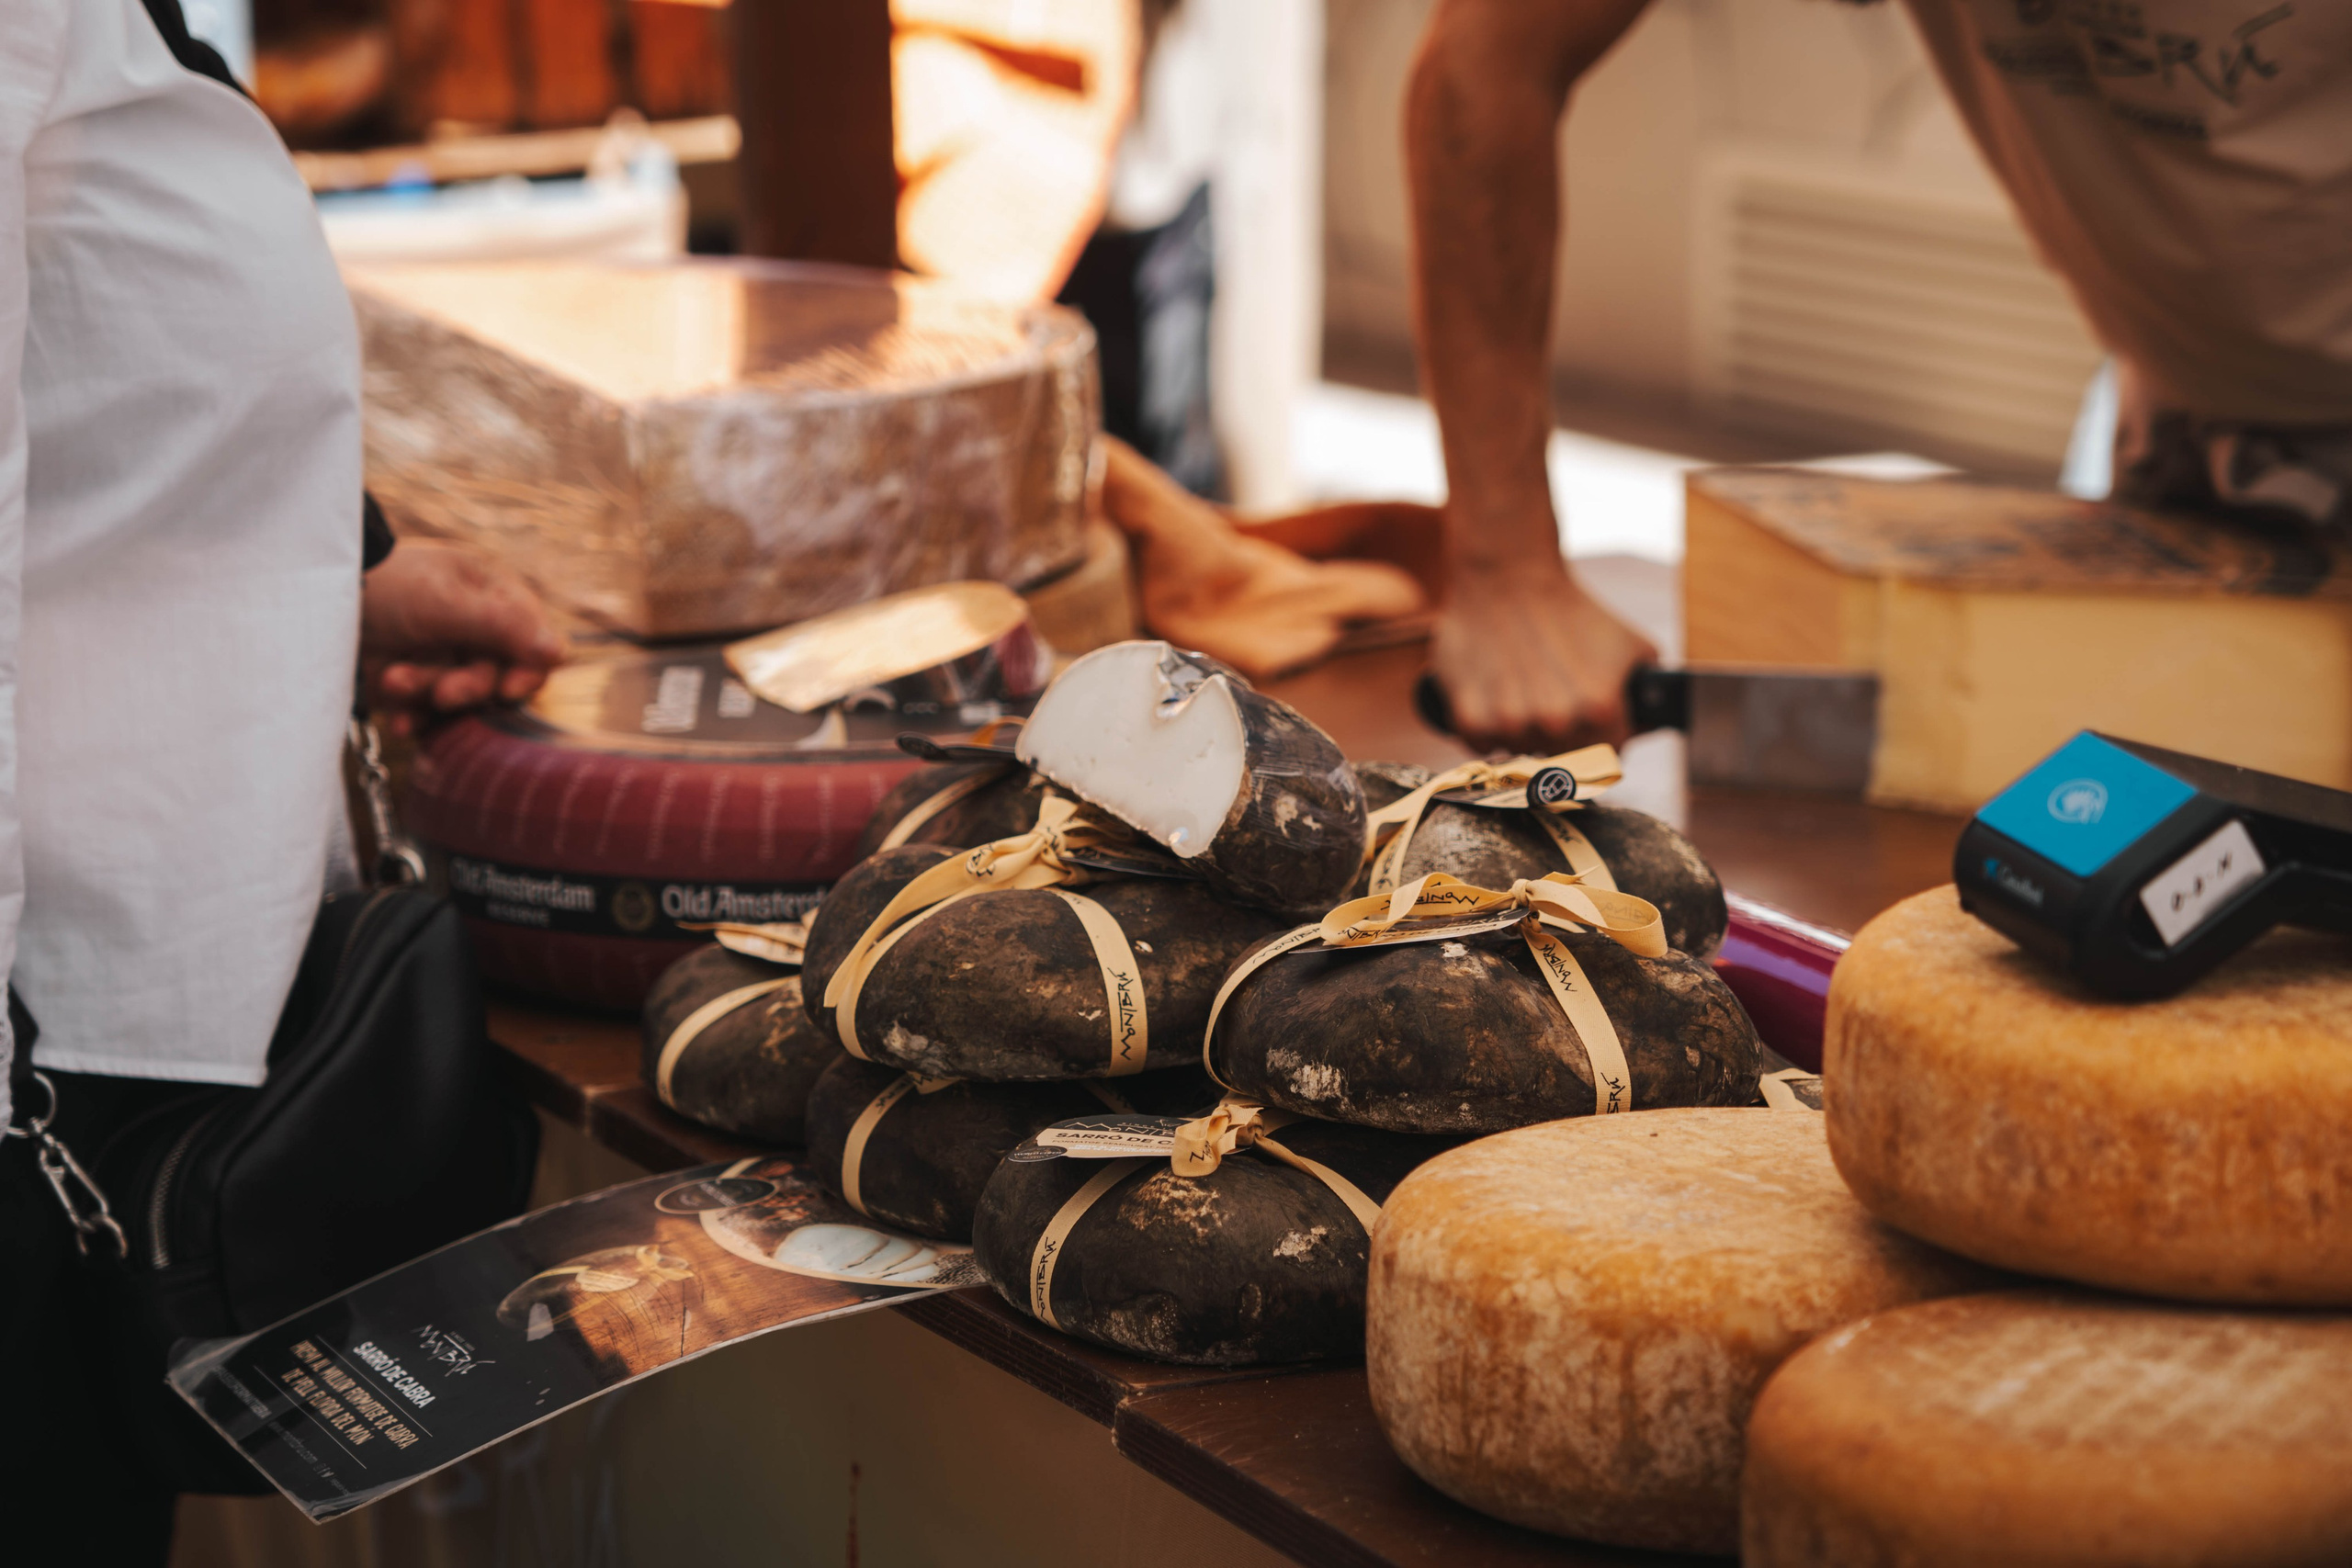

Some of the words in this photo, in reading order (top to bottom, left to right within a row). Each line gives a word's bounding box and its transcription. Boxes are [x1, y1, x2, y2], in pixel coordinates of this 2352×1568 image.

[661, 884, 712, 919] Old
[713, 885, 829, 919] Amsterd
[1056, 1133, 1124, 1141] SARRÓ
[352, 1340, 401, 1372] SARRÓ
[381, 1363, 409, 1383] DE
[343, 1382, 390, 1423] FORMATGE
[393, 1376, 436, 1409] CABRA
[330, 1411, 357, 1431] DEL
[344, 1423, 375, 1447] MÓN
[373, 1414, 396, 1430] DE
[384, 1422, 421, 1451] CABRA
